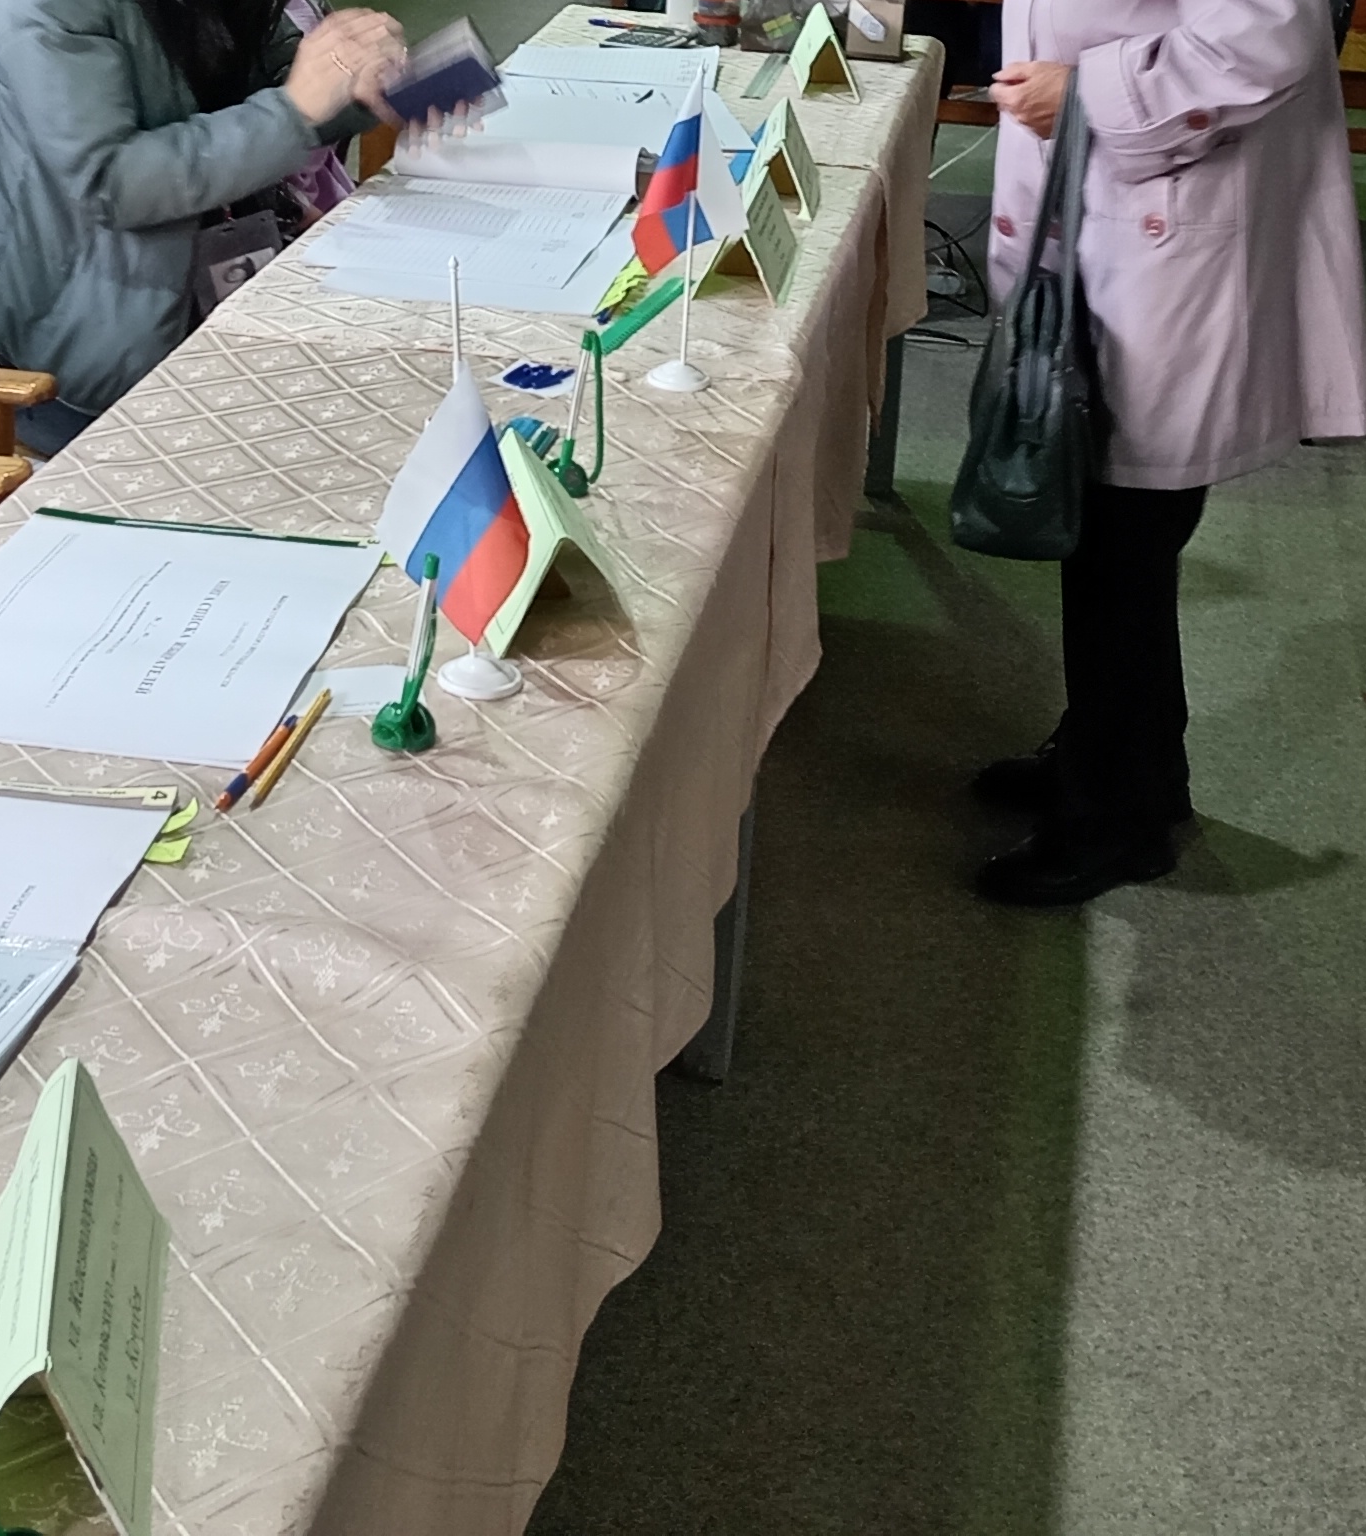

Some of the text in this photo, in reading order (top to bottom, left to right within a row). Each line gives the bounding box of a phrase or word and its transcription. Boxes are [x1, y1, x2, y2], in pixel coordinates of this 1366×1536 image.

[179, 602, 212, 638] СПИСКА
[135, 641, 187, 695] ИЗБИРАТЕЛЕЙ
[151, 790, 168, 800] 4
